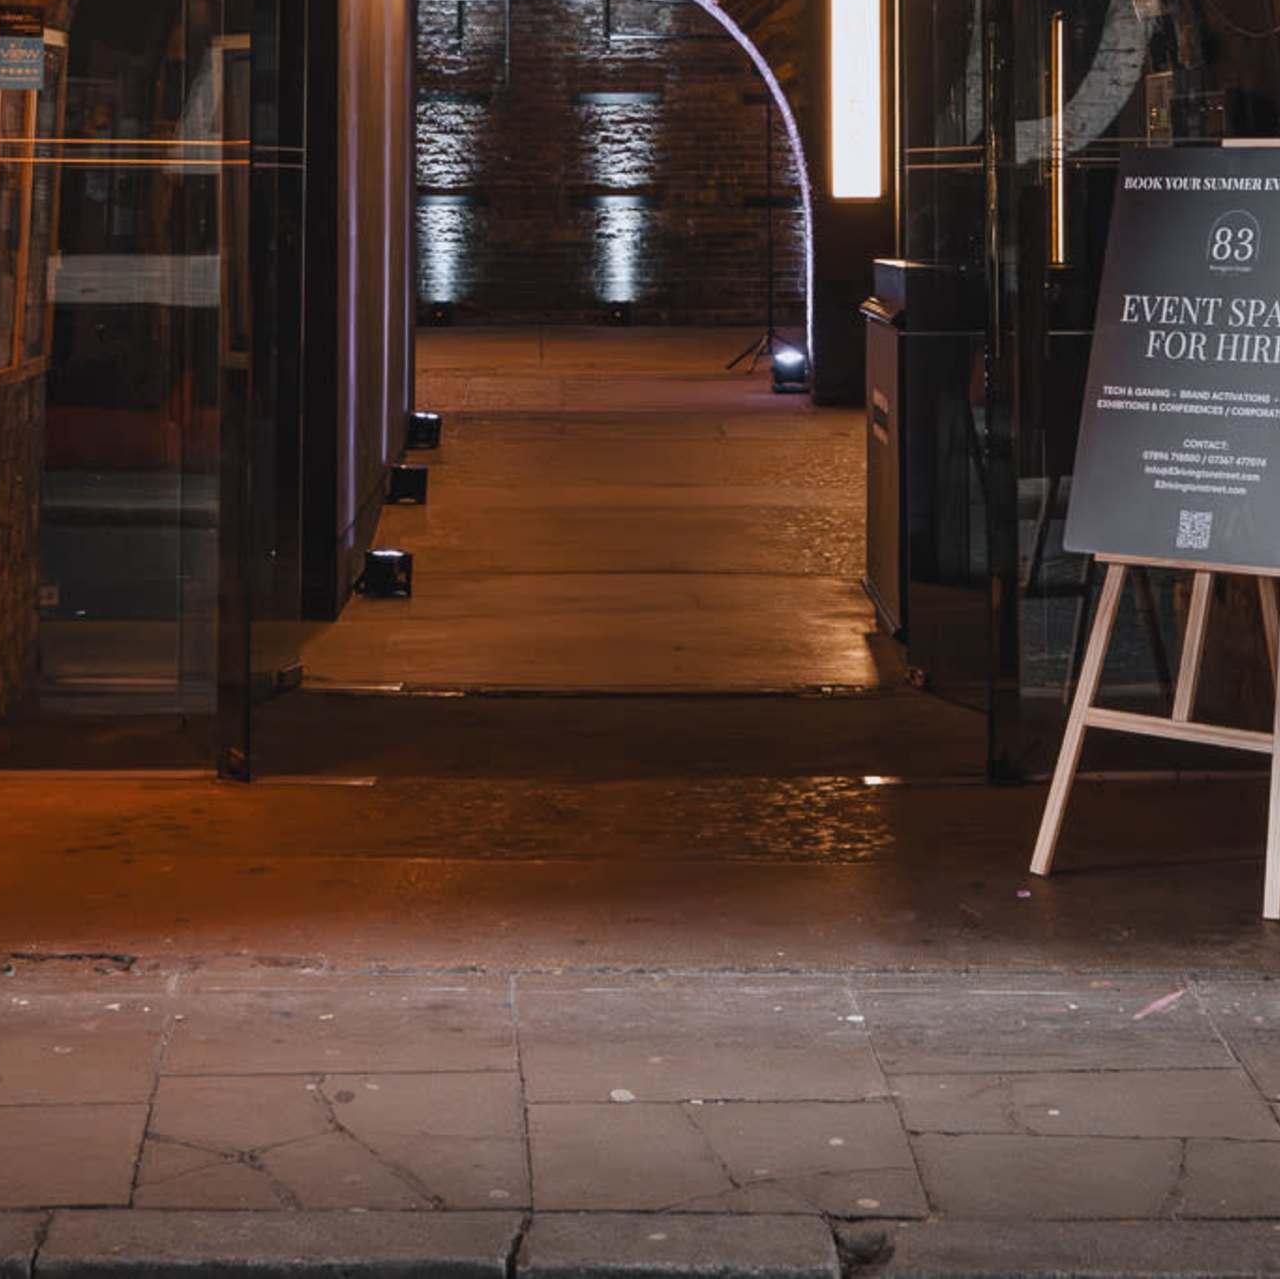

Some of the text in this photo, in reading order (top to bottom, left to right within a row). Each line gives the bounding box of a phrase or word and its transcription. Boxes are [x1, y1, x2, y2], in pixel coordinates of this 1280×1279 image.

[1124, 176, 1162, 190] BOOK
[1165, 177, 1201, 190] YOUR
[1203, 177, 1262, 191] SUMMER
[1211, 227, 1254, 262] 83
[1120, 294, 1223, 326] EVENT
[1145, 330, 1207, 361] FOR
[1103, 386, 1126, 396] TECH
[1135, 387, 1170, 398] GAMING
[1180, 390, 1210, 400] BRAND
[1212, 392, 1270, 403] ACTIVATIONS
[1096, 399, 1151, 410] EXHIBITIONS
[1159, 402, 1224, 415] CONFERENCES
